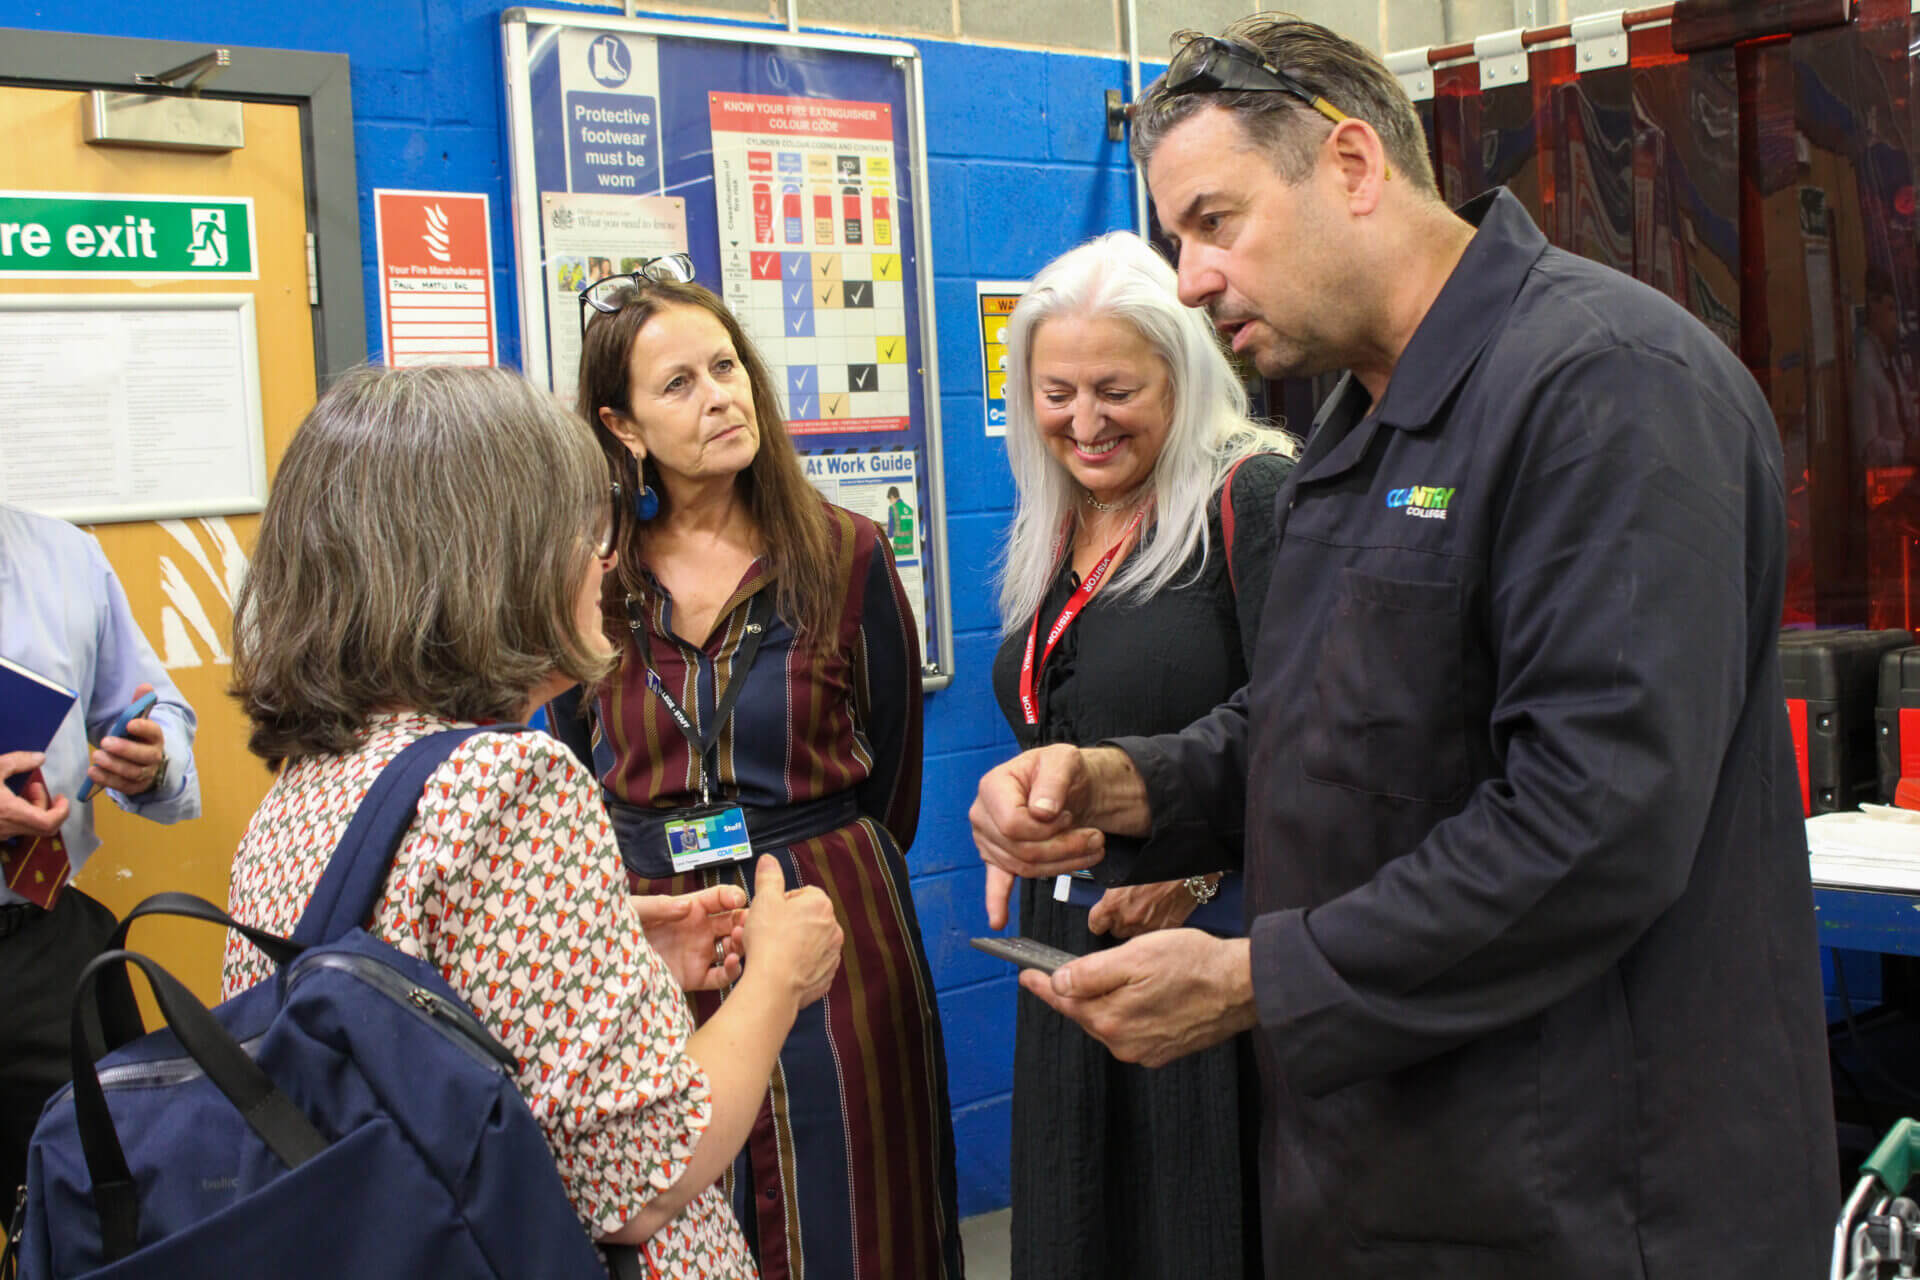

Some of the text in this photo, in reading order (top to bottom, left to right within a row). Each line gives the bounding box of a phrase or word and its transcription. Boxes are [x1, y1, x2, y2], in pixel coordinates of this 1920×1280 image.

[575, 104, 650, 126] Protective
[723, 101, 877, 121] KNOW YOUR FIRE EXTINGUISHER
[769, 118, 839, 132] COLOUR CODE
[581, 127, 647, 146] footwear
[585, 150, 645, 167] must be
[597, 174, 635, 188] worn
[66, 215, 157, 258] exit
[388, 264, 409, 275] Your
[411, 265, 427, 275] Fire
[429, 265, 467, 276] Marshals
[805, 454, 912, 476] At Work Guide
[1082, 557, 1110, 593] VISITOR
[1047, 610, 1073, 645] VISITOR
[723, 822, 742, 833] Staff
